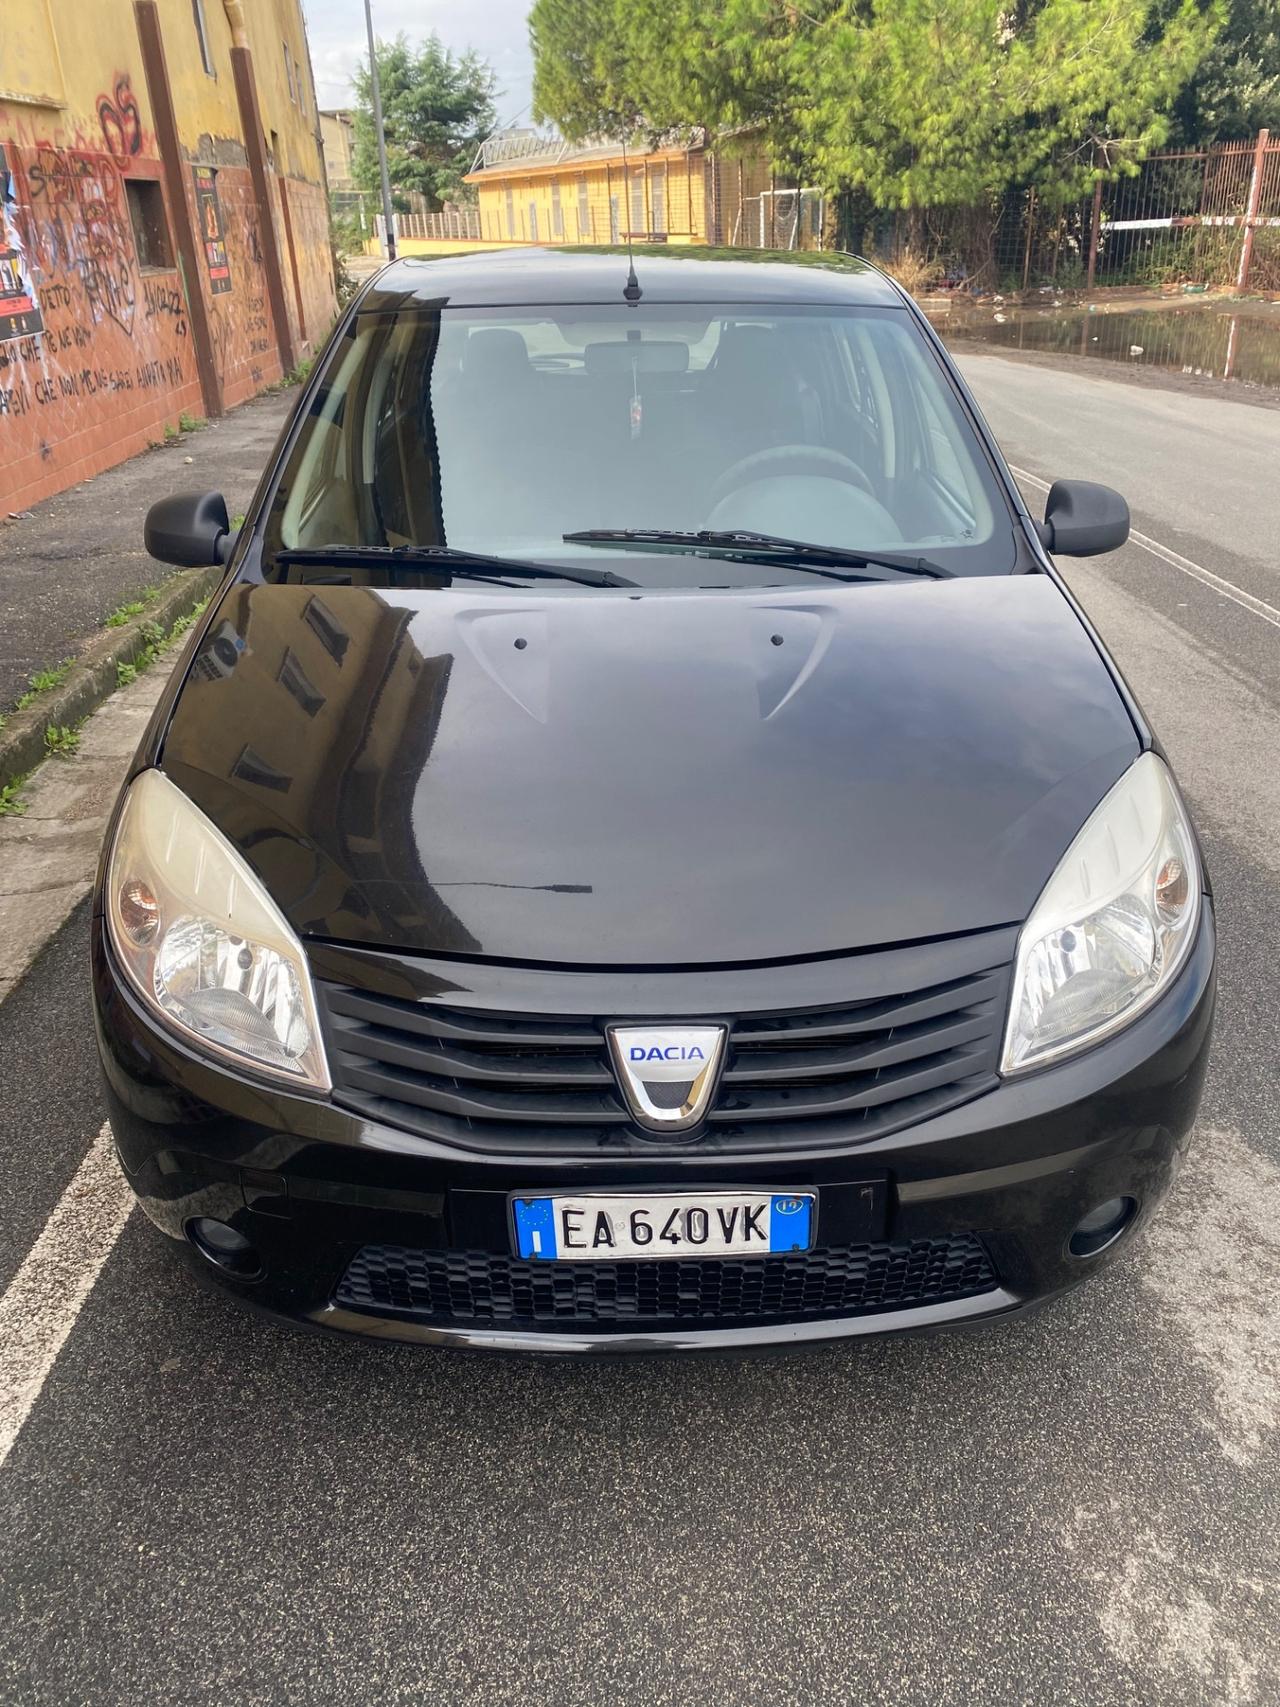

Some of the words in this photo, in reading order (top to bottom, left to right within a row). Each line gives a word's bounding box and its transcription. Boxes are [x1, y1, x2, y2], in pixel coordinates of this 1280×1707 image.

[34, 378, 57, 405] CHE
[58, 373, 80, 398] NON
[630, 1047, 704, 1061] DACIA
